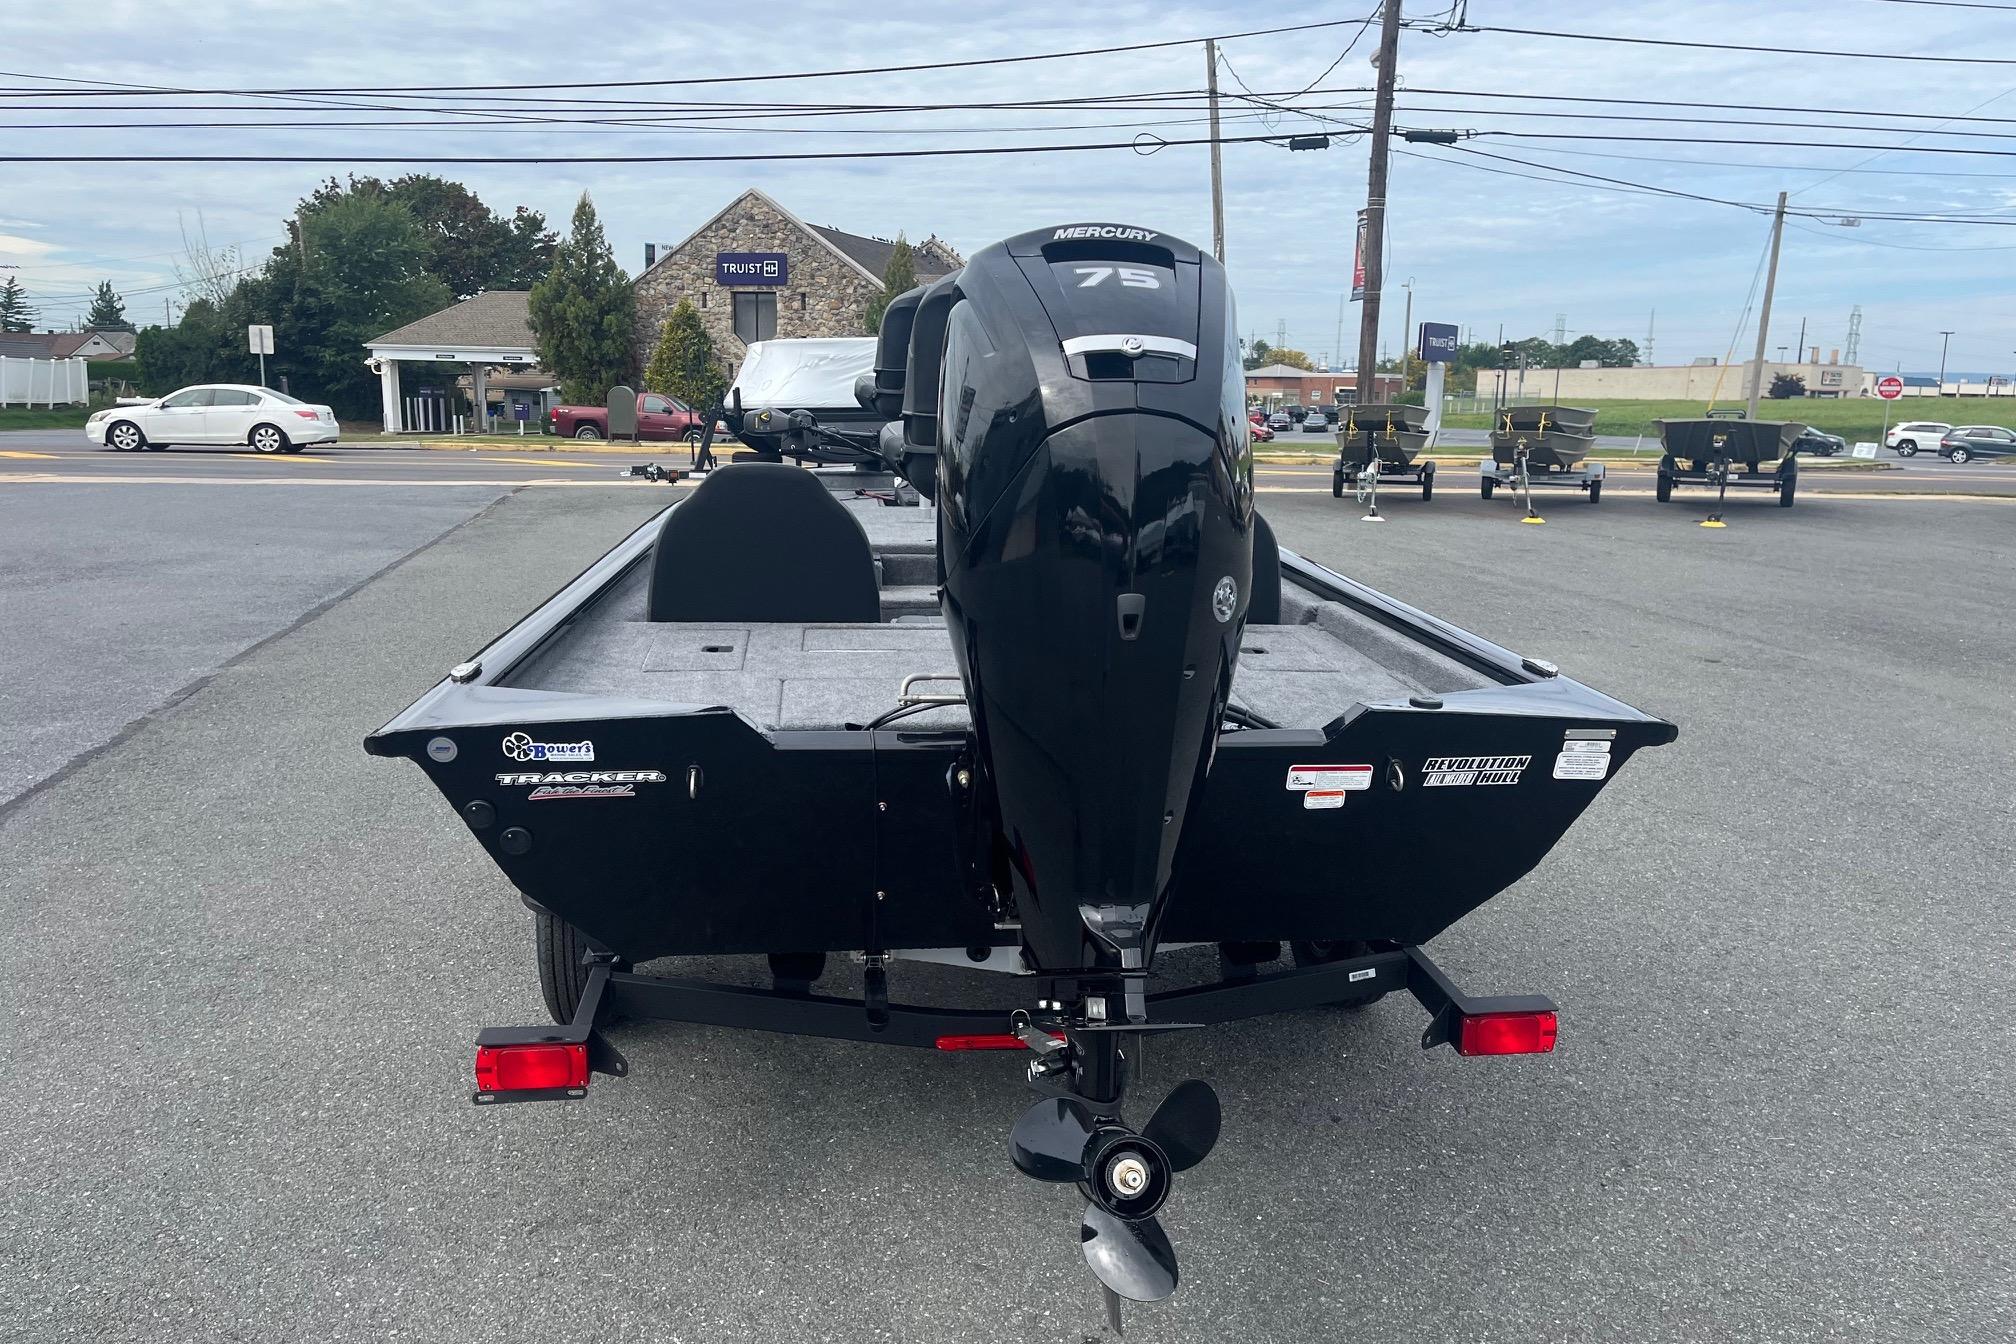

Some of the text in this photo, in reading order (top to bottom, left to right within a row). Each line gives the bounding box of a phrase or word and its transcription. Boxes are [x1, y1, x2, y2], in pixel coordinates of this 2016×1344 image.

[1053, 226, 1158, 241] MERCURY
[722, 263, 762, 274] TRUIST
[1074, 267, 1161, 289] 75
[1429, 337, 1448, 348] TRUIST
[1422, 756, 1531, 771] REVOLUTION
[496, 772, 660, 785] TRACKER
[1478, 771, 1521, 784] HULL
